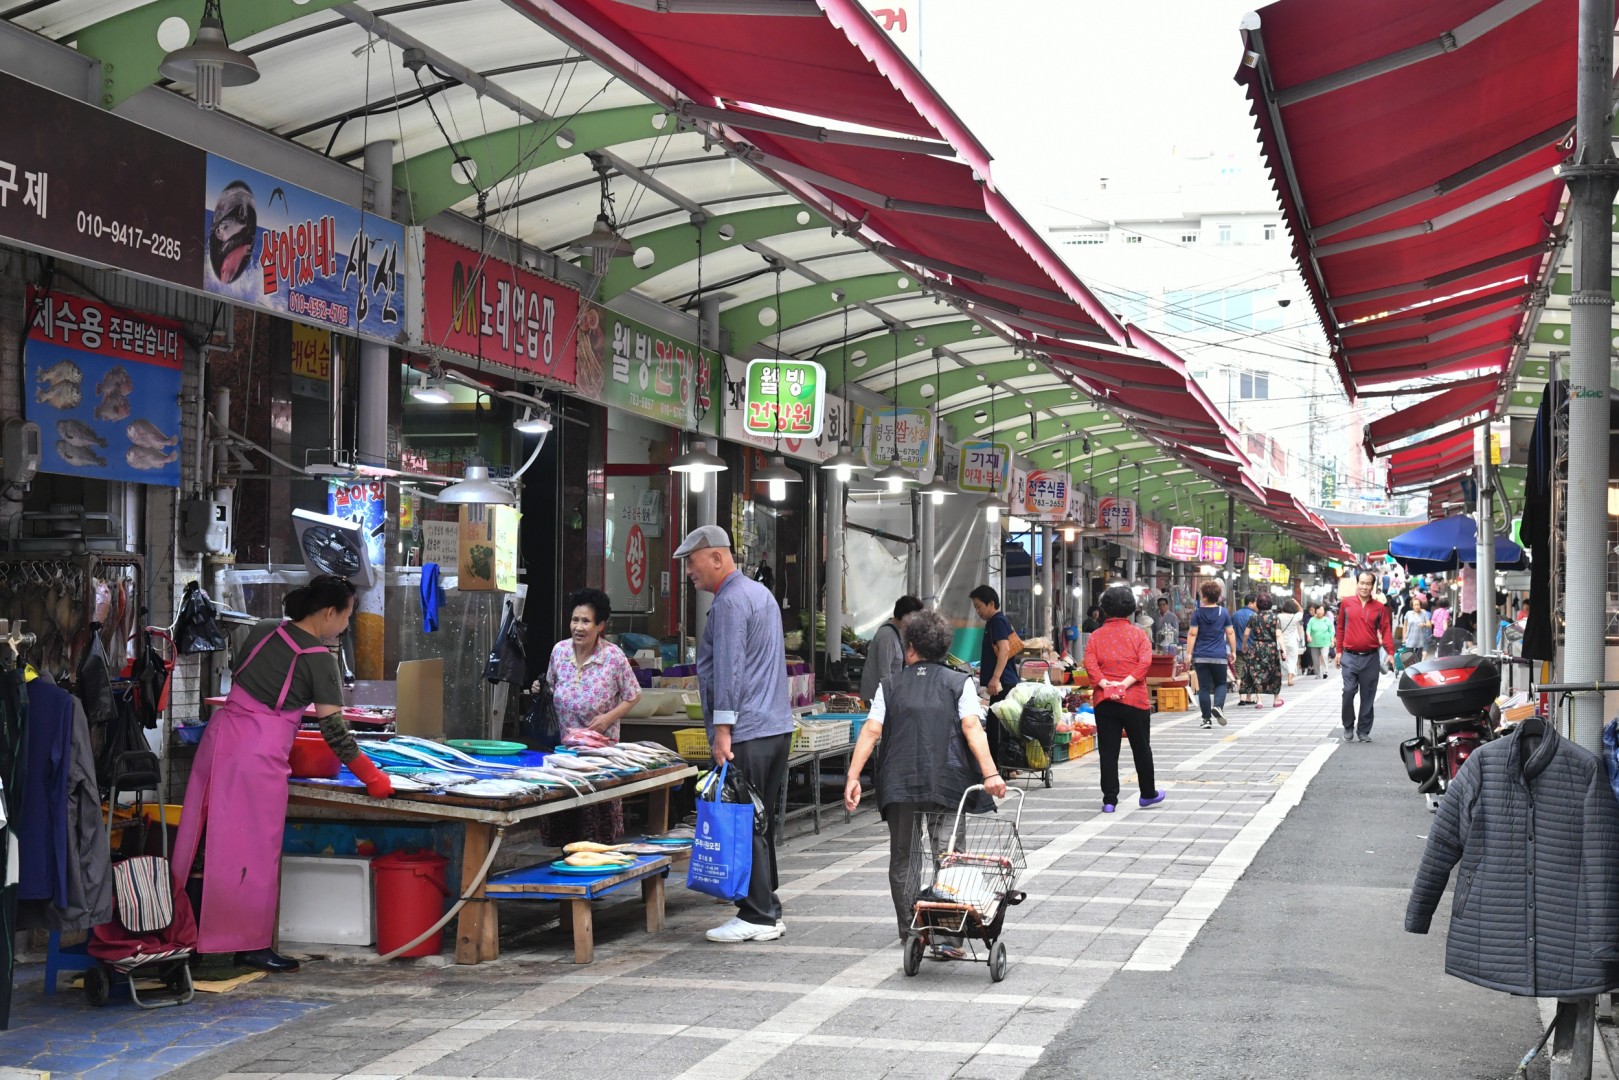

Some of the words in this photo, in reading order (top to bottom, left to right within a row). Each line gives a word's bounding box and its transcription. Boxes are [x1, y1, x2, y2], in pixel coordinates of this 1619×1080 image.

[76, 210, 181, 262] 010-9417-2285
[260, 214, 337, 296] 살아있네!
[289, 290, 348, 325] 010-4552-4705
[109, 317, 178, 360] 주문받습니다
[750, 401, 812, 431] 건강원
[1028, 480, 1065, 498] 전주식품
